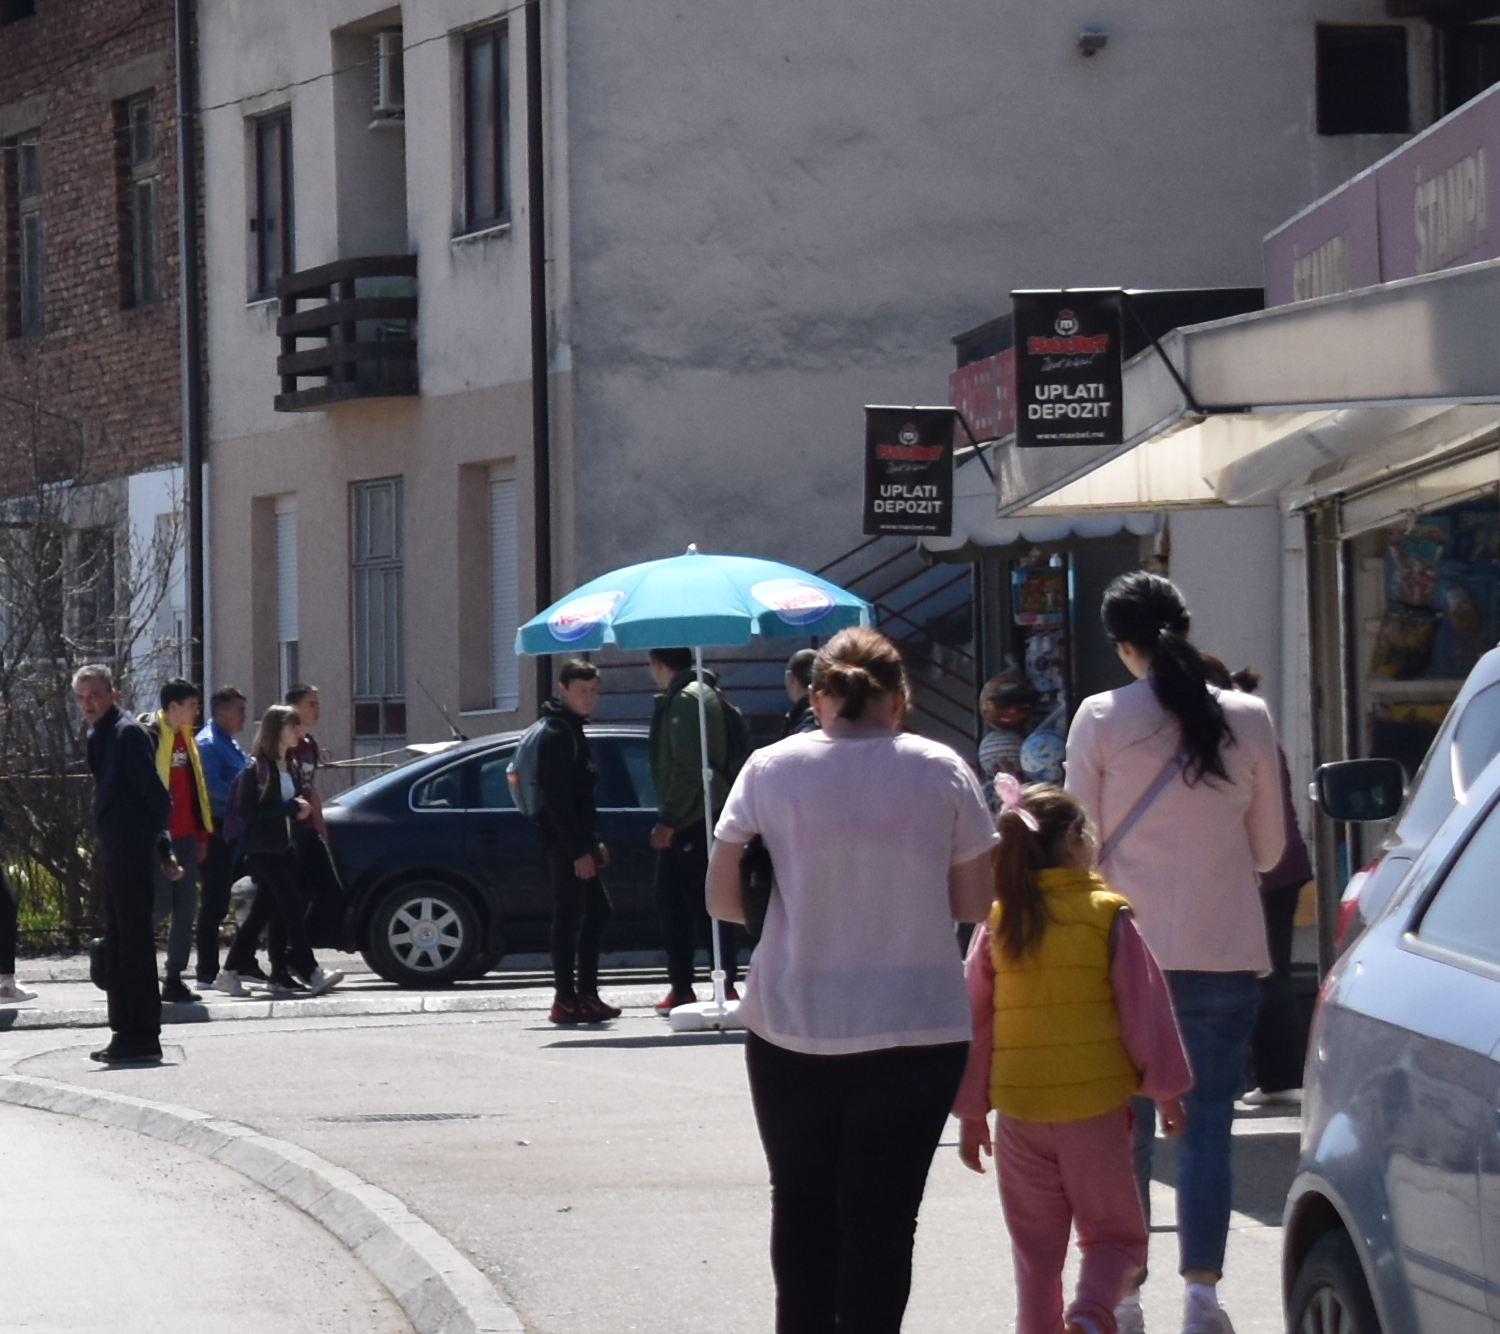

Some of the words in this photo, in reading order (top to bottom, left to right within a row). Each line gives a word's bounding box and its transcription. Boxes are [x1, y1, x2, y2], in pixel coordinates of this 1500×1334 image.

[1035, 383, 1104, 400] UPLATI
[1028, 402, 1111, 419] DEPOZIT
[880, 484, 937, 498] UPLATI
[873, 499, 943, 514] DEPOZIT
